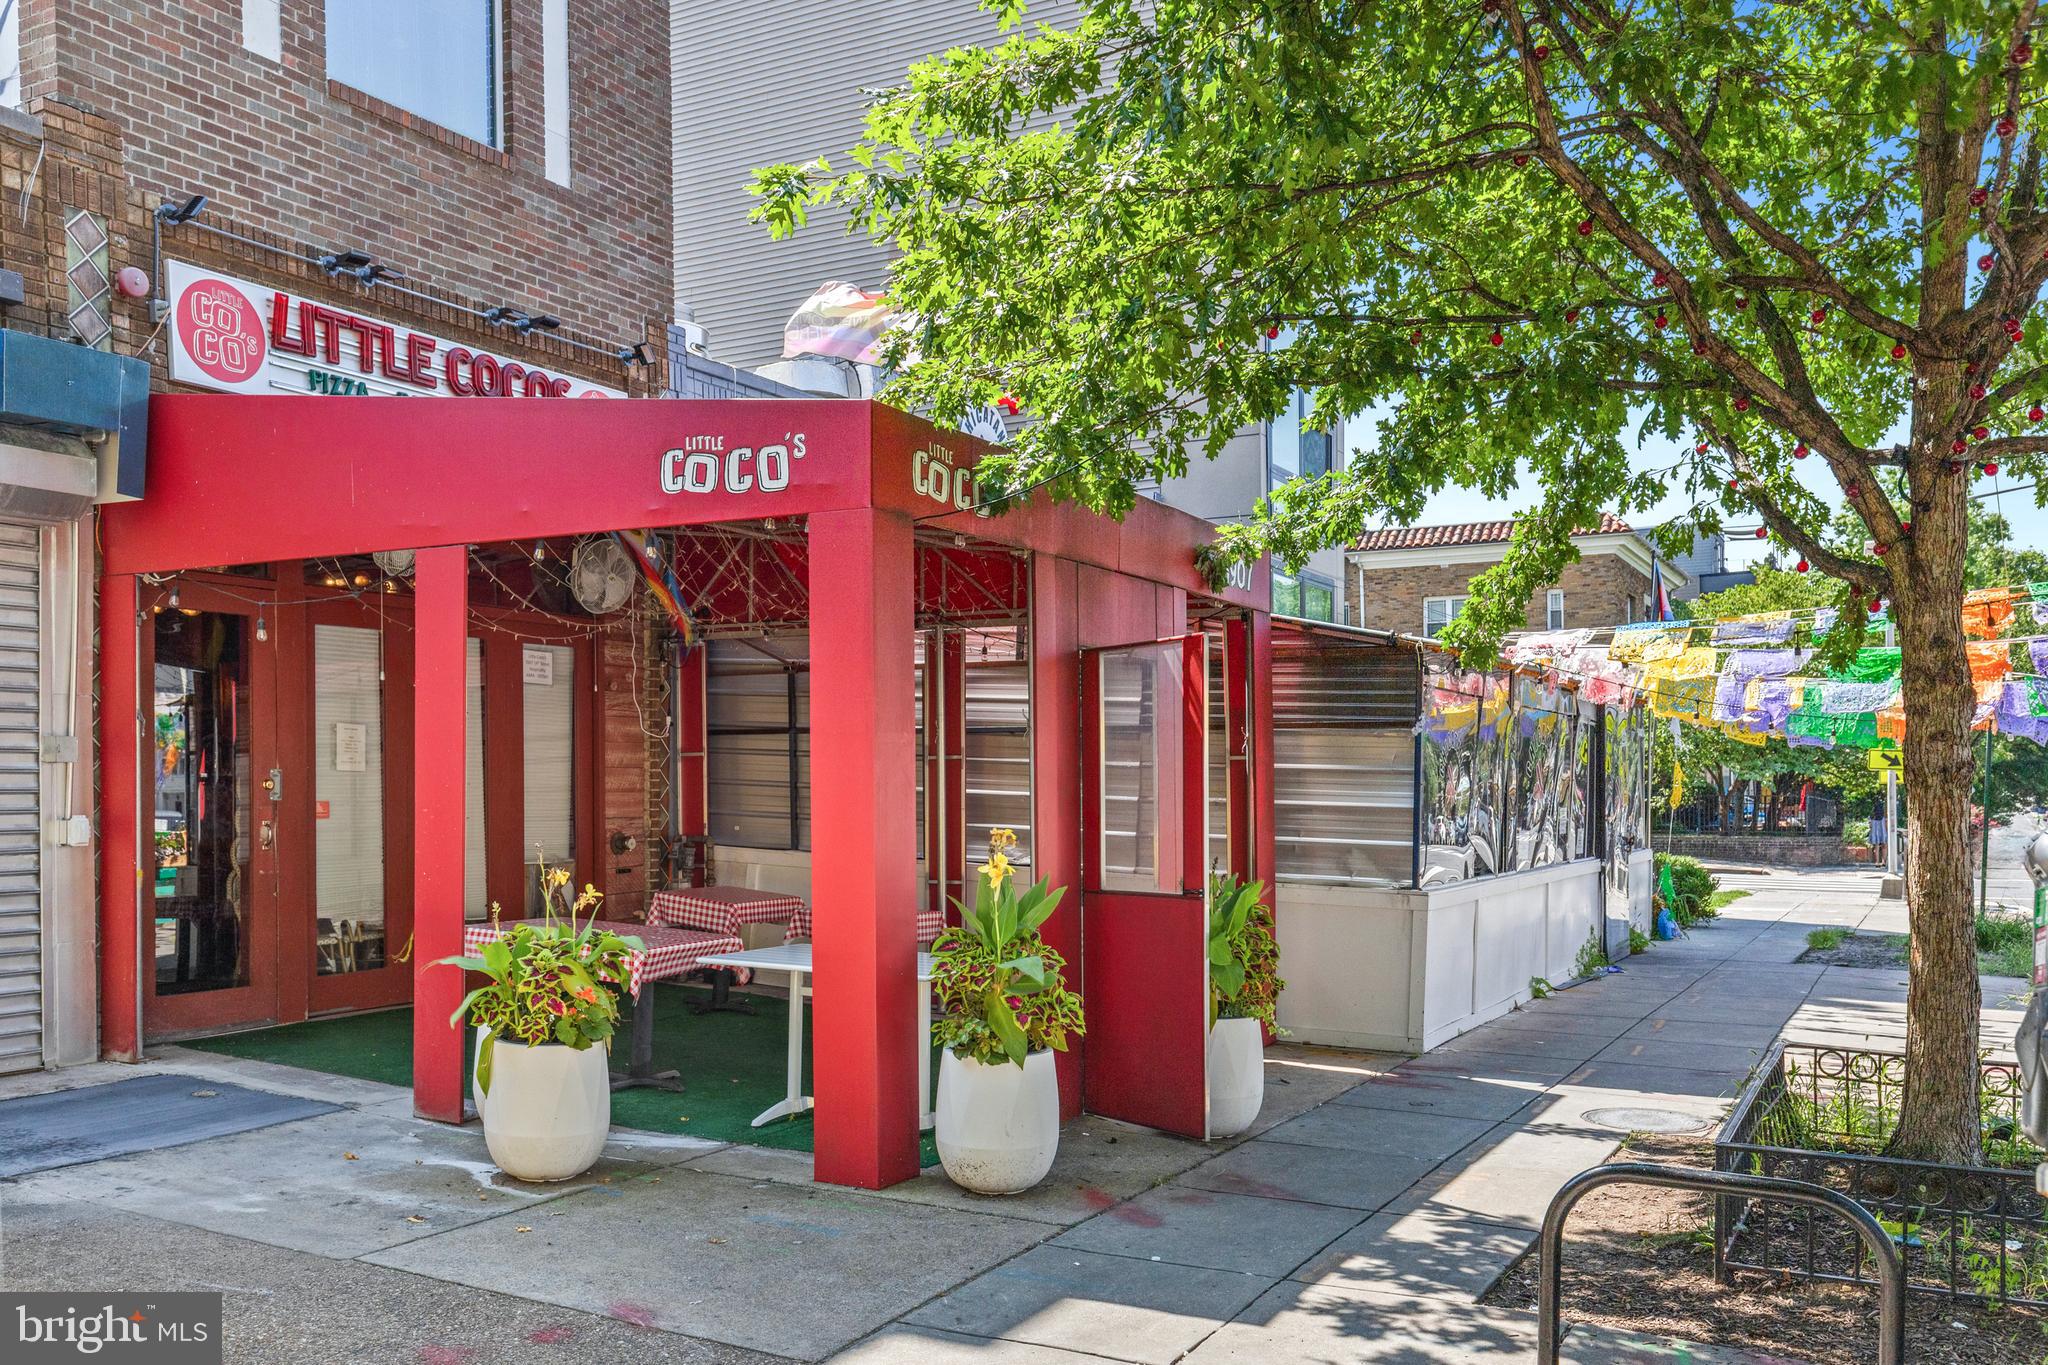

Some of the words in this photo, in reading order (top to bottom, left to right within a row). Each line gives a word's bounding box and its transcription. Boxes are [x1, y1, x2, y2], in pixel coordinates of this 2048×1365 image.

[211, 287, 243, 309] LITTLE
[271, 291, 437, 389] LITTLE
[308, 369, 369, 396] PIZZA
[685, 436, 724, 450] LITTLE
[929, 441, 953, 465] LITTLE
[660, 432, 806, 494] COCO'S
[1226, 559, 1253, 592] 907
